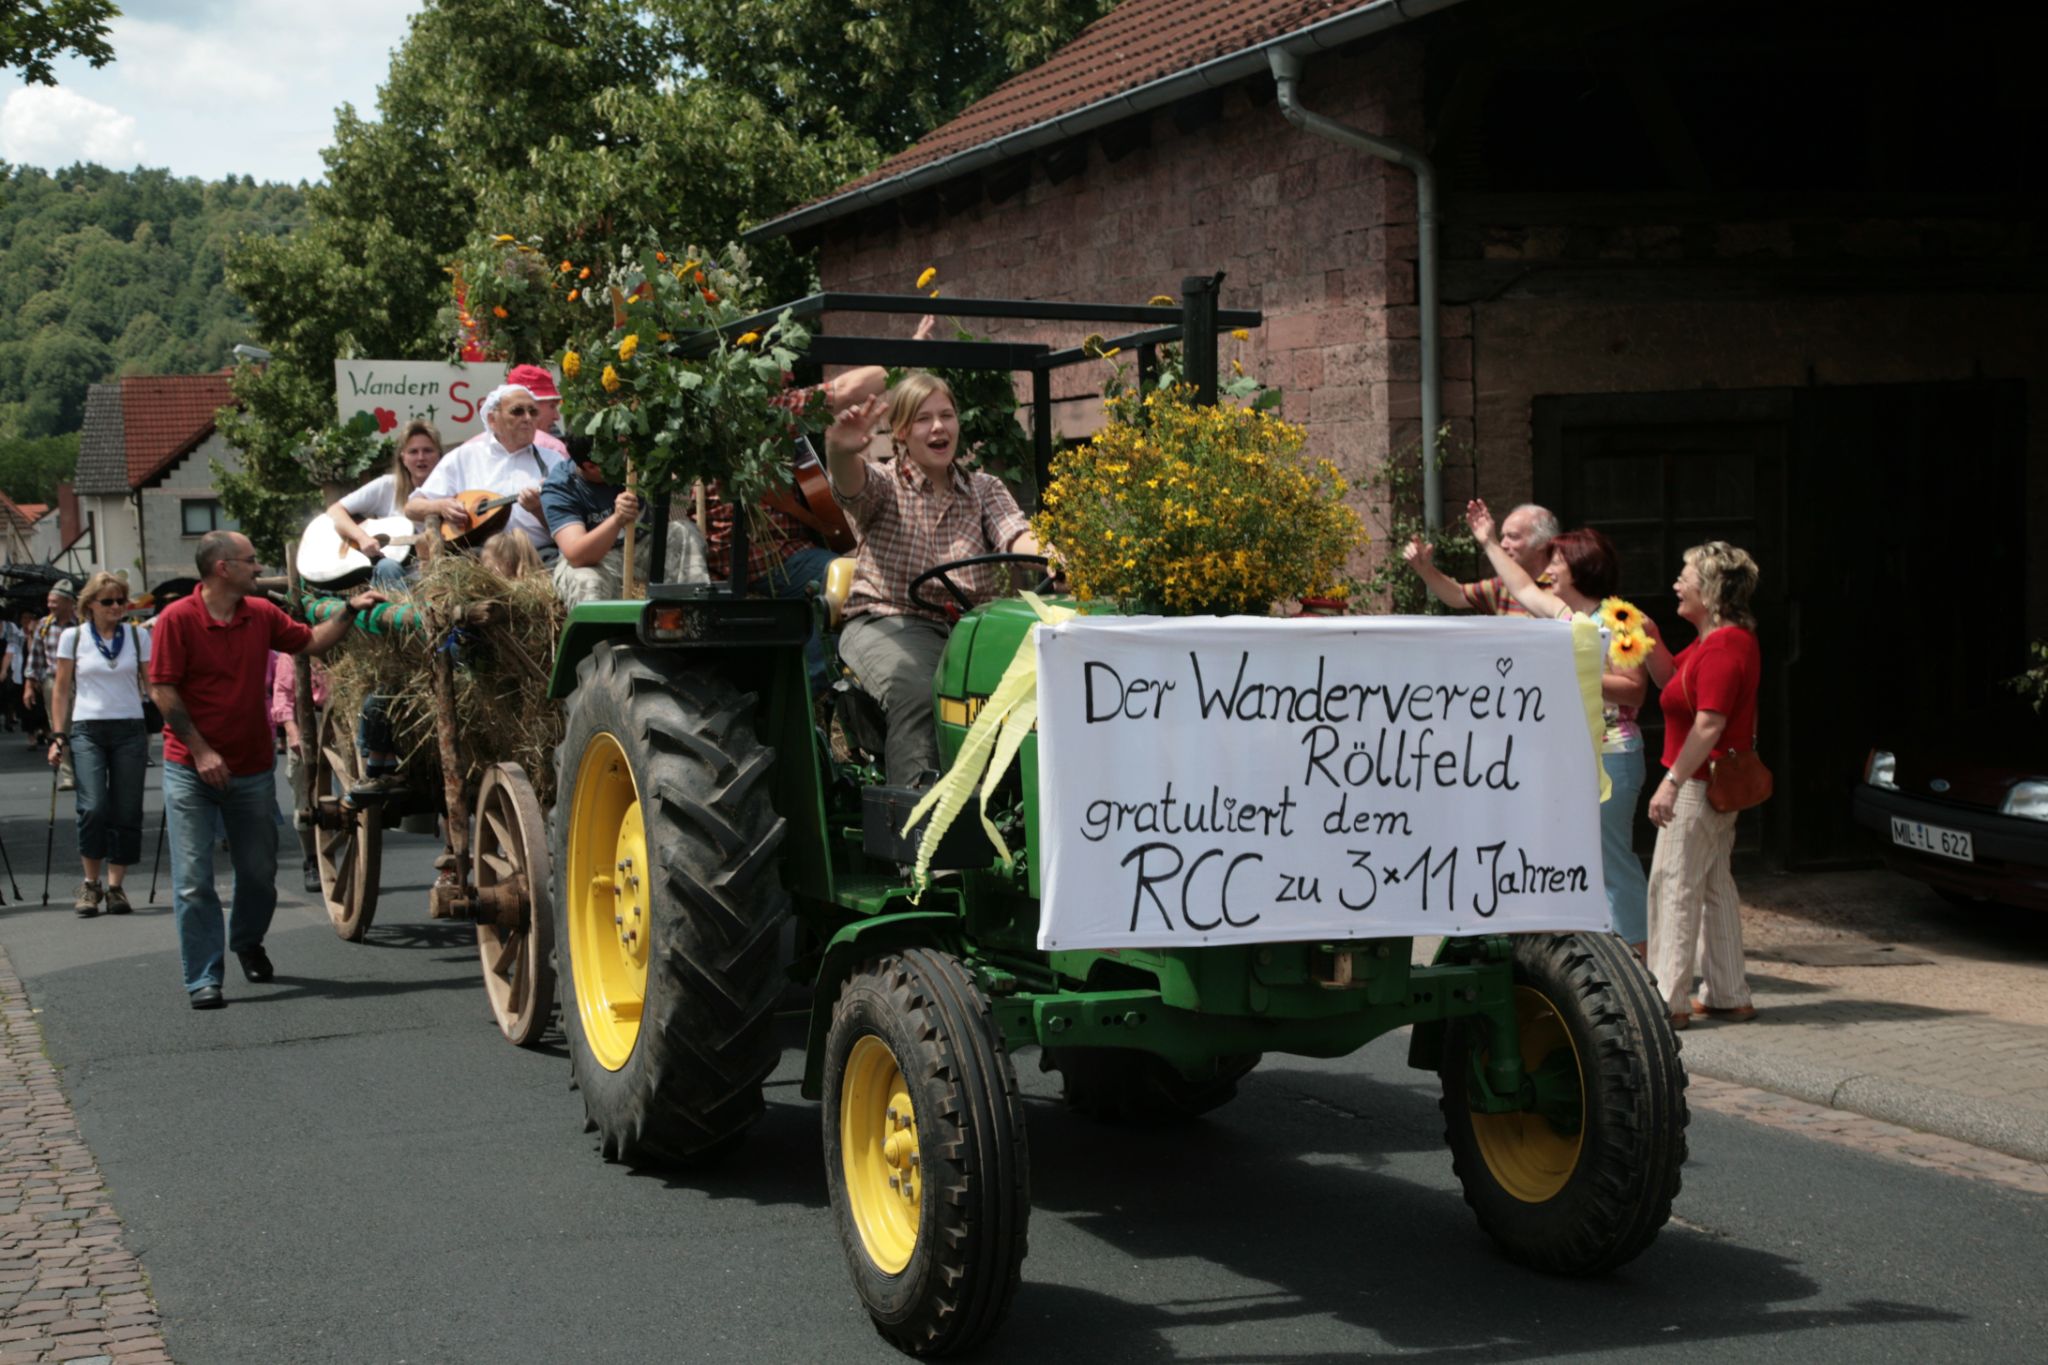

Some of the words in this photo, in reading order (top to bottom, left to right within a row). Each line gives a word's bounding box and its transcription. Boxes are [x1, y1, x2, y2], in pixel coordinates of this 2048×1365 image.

[348, 371, 440, 397] Wandern
[1083, 661, 1176, 724] Der
[1189, 650, 1546, 724] Wanderverein
[1301, 724, 1520, 793] Röllfeld
[1080, 781, 1297, 841] gratuliert
[1323, 792, 1413, 836] dem
[1941, 831, 1970, 858] 622
[1120, 841, 1264, 932] RCC
[1275, 873, 1322, 904] zu
[1472, 840, 1589, 918] Jahren
